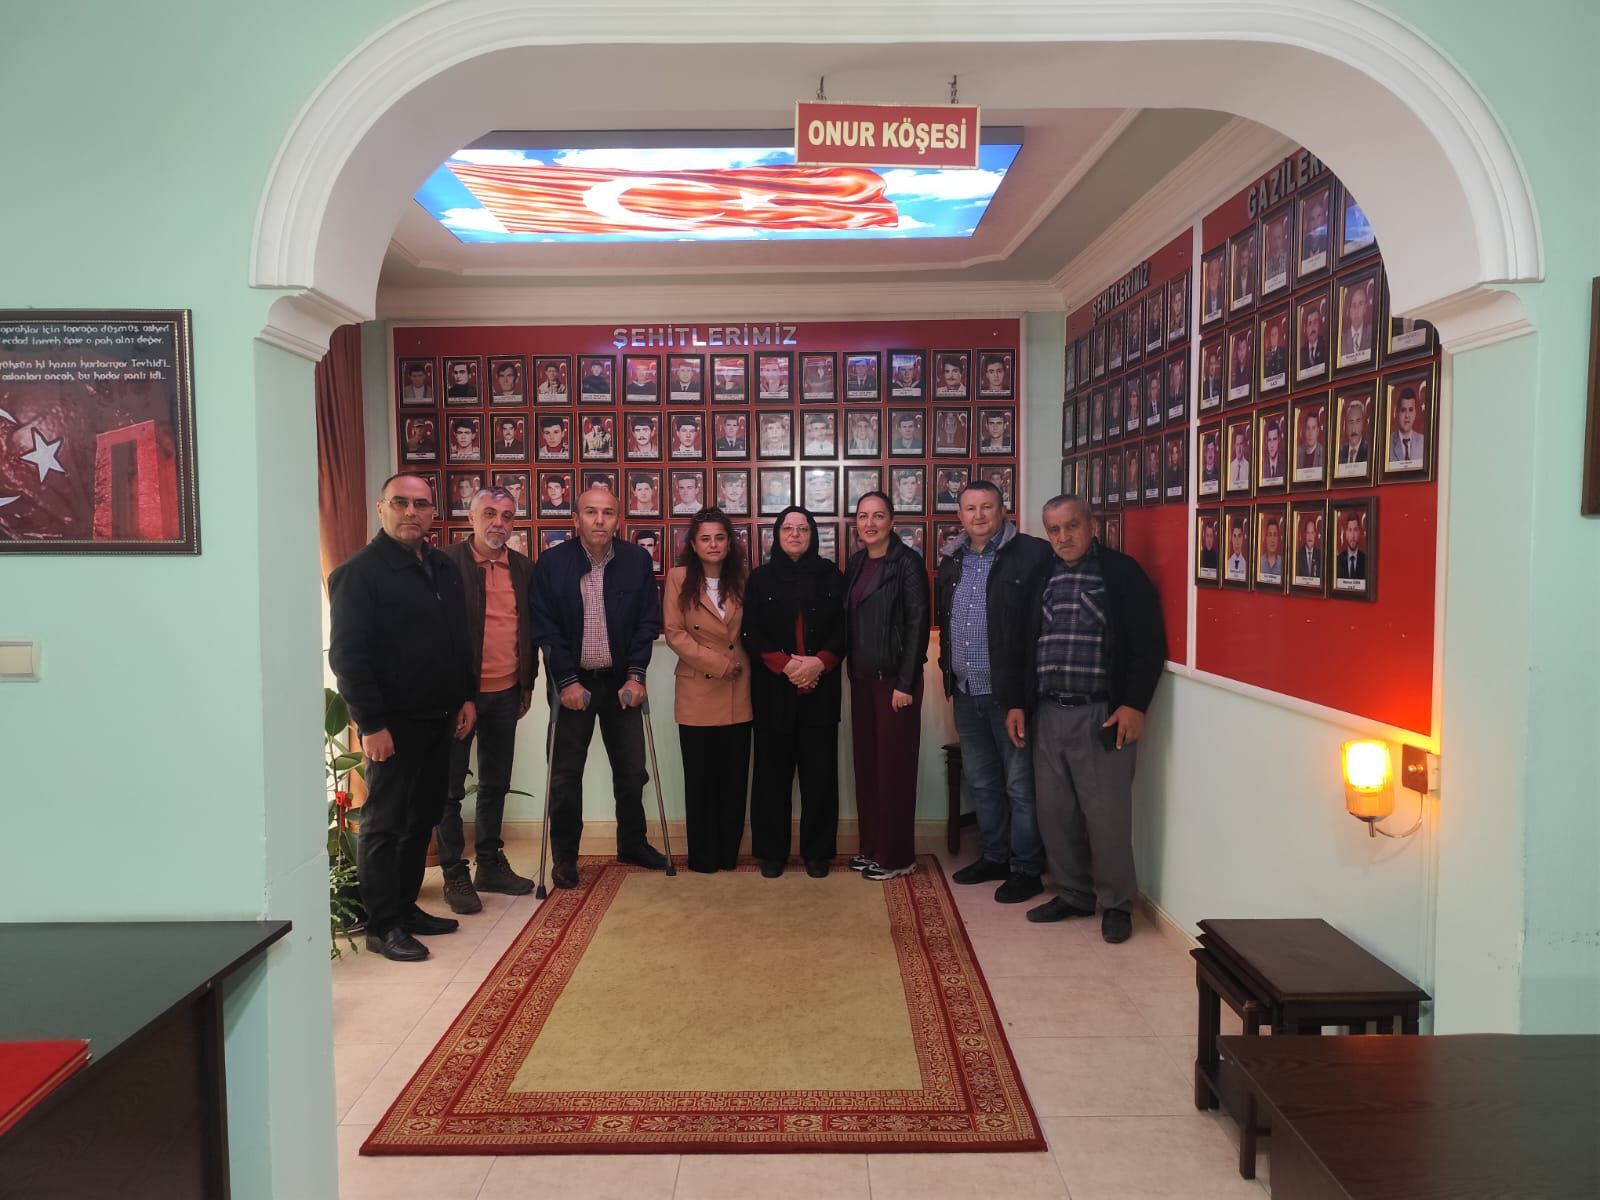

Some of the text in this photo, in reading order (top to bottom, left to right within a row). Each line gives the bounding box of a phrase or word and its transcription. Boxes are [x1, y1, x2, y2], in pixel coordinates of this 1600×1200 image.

[808, 117, 967, 155] ONUR KÖŞESİ
[1247, 148, 1327, 219] GAZİLER
[612, 322, 798, 350] ŞEHİTLERİMİZ
